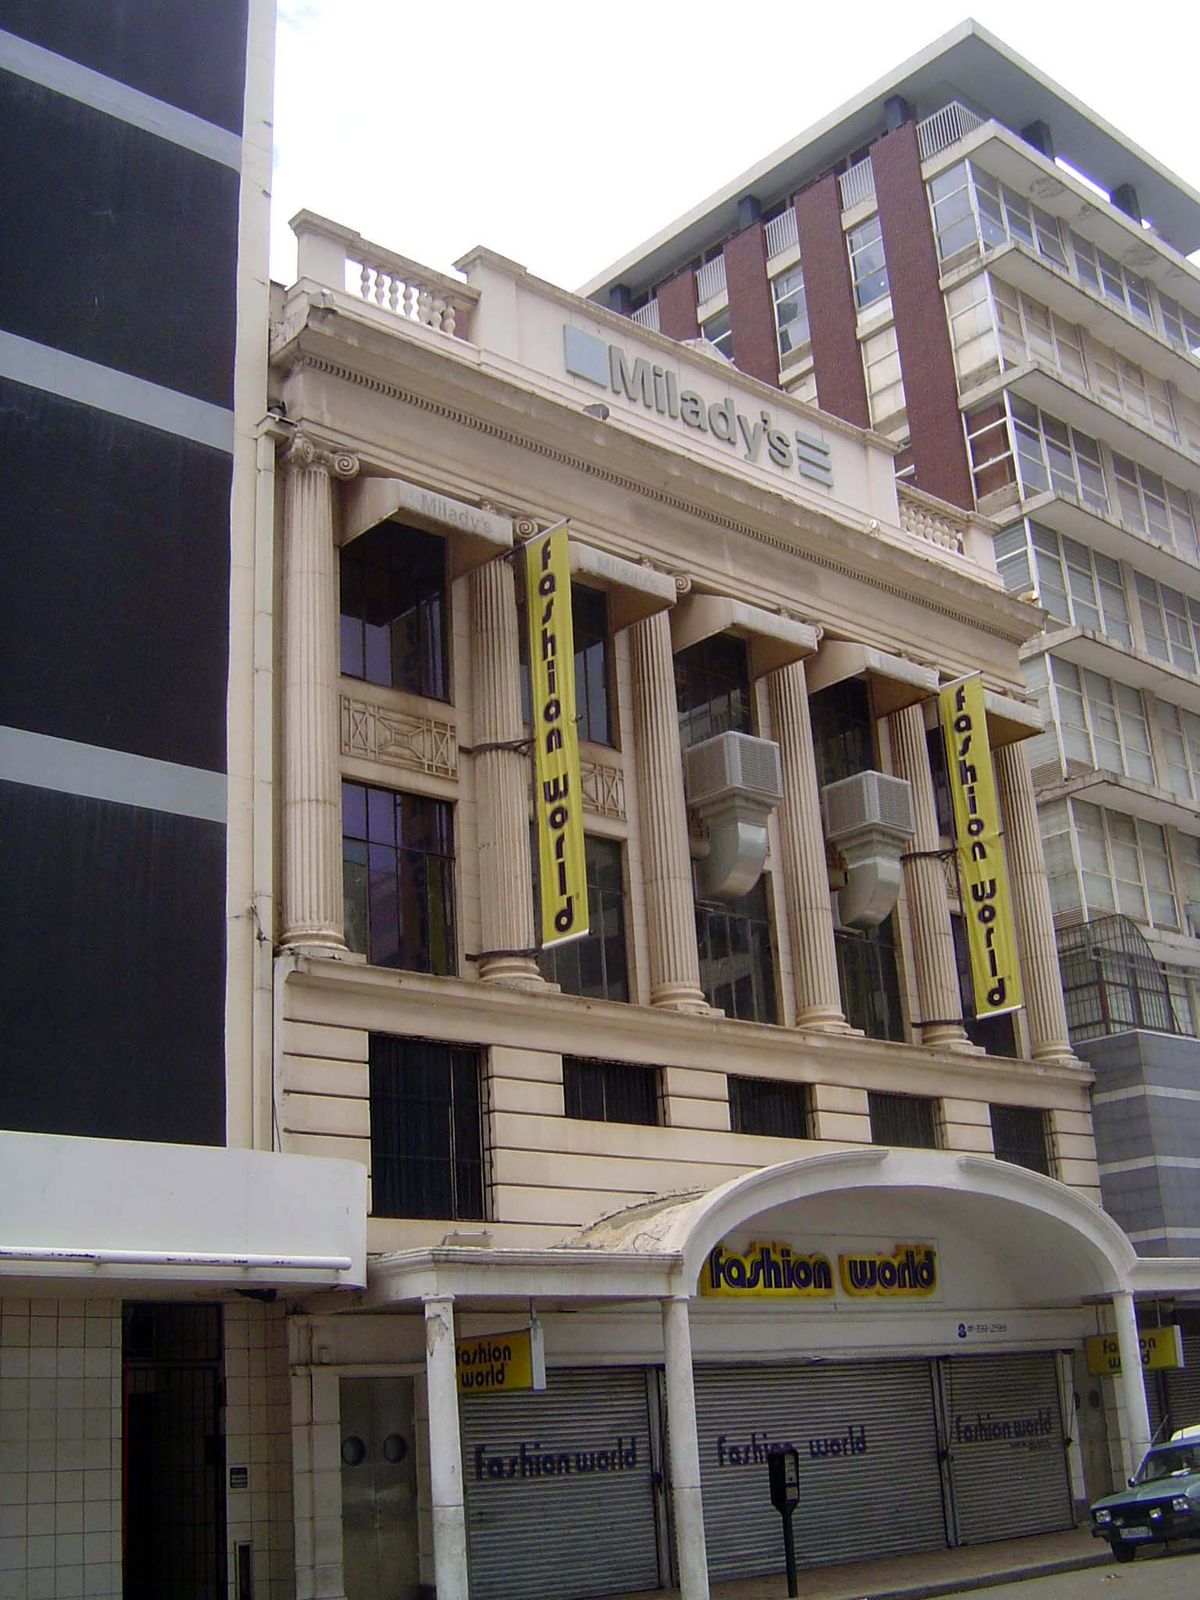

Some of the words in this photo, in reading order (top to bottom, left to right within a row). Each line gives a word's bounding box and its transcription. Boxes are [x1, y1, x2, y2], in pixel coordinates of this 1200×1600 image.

[608, 344, 794, 468] Milady's
[538, 537, 562, 754] fashion
[543, 772, 574, 933] world
[953, 684, 988, 862] fashion
[971, 878, 1006, 1006] world
[710, 1246, 833, 1290] fashion
[848, 1249, 937, 1290] world
[455, 1342, 512, 1366] fashion
[461, 1362, 506, 1388] world
[473, 1440, 570, 1480] fashion
[575, 1435, 638, 1473] world
[809, 1424, 867, 1458] world
